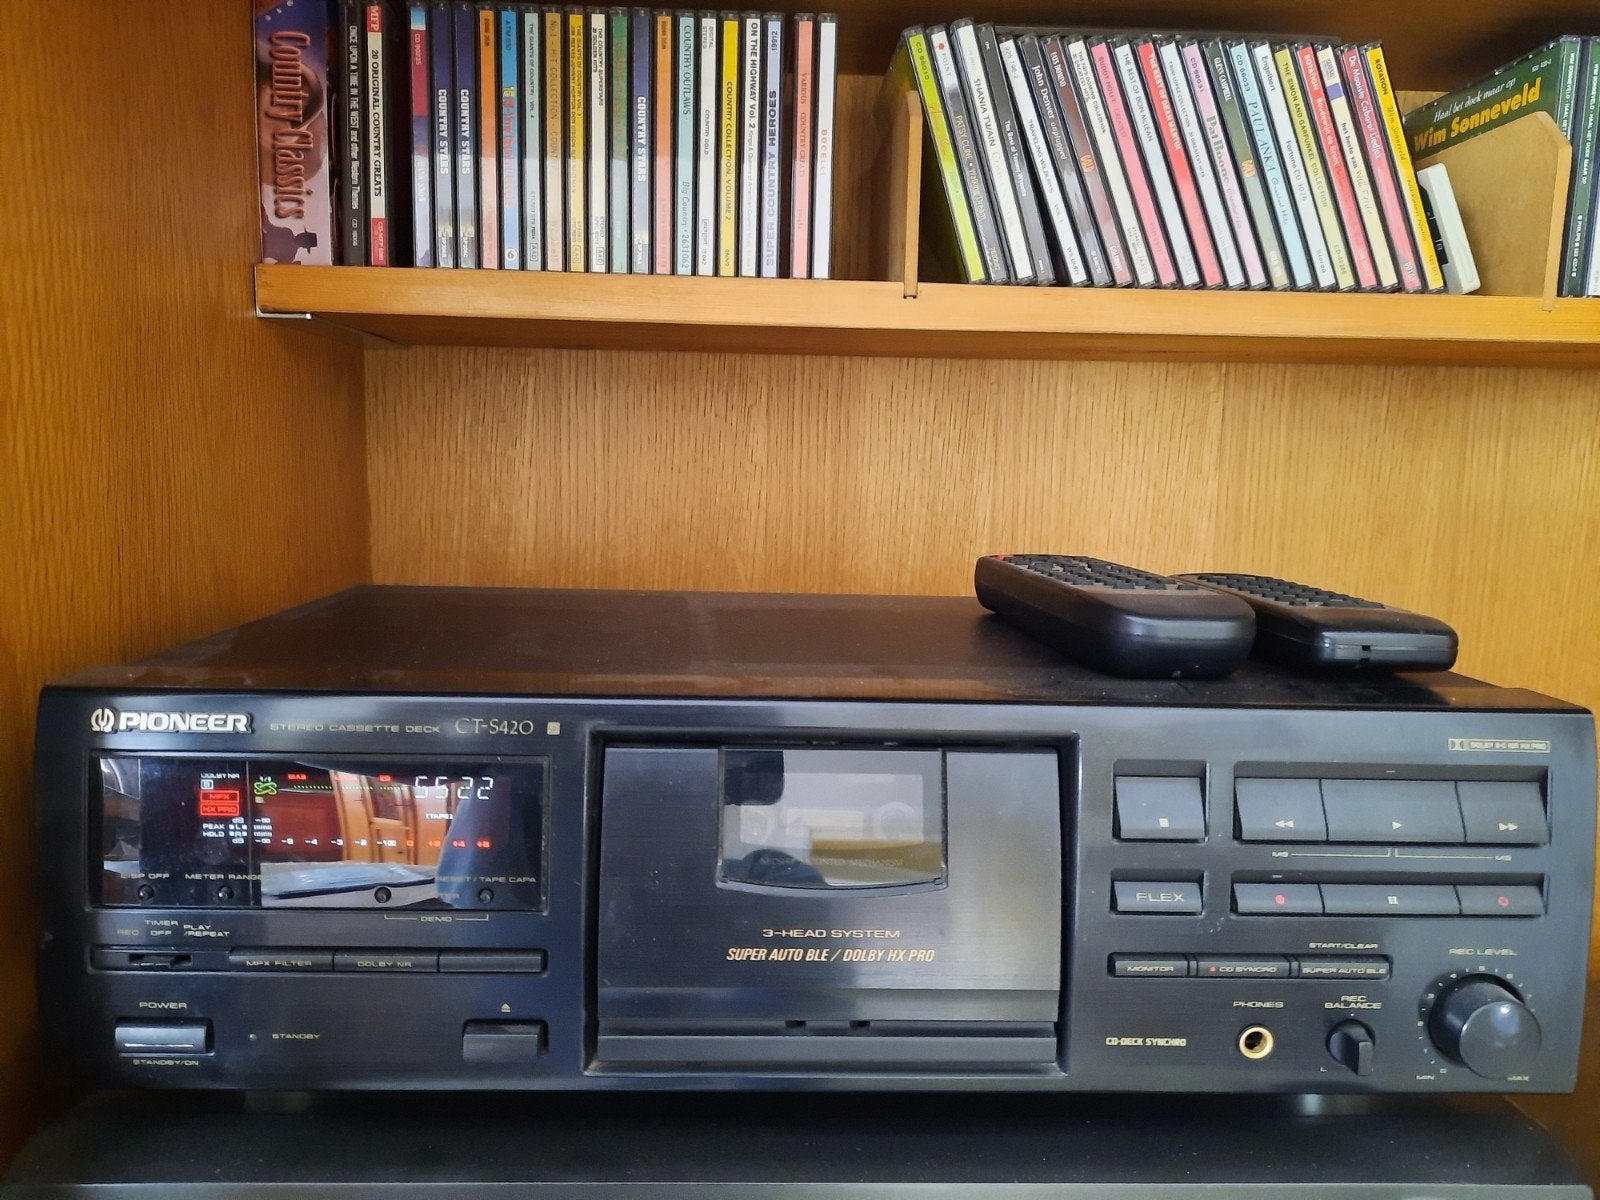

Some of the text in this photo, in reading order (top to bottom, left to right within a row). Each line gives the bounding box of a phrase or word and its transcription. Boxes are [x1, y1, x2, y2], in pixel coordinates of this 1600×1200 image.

[370, 6, 380, 31] MFP
[750, 22, 758, 36] ON
[415, 34, 420, 43] CD
[750, 39, 758, 58] THE
[915, 41, 923, 53] CD
[550, 49, 558, 64] HIT
[682, 26, 692, 115] COUNTRY OUTLAWS
[940, 52, 951, 76] POINT
[1049, 51, 1067, 87] FATS DOMINO
[1122, 52, 1131, 66] THE
[1189, 56, 1197, 68] CD
[1235, 53, 1243, 65] CD
[1260, 55, 1276, 91] Engelbert
[750, 60, 758, 102] HIGHWAY
[800, 72, 808, 104] VARIOUS
[1097, 56, 1116, 102] BUDDY HOLLY
[1126, 67, 1136, 83] BEST
[1131, 84, 1139, 93] OF
[1218, 74, 1232, 101] CAMPBELL
[550, 68, 558, 119] COLLECTION
[1134, 95, 1145, 113] DON
[1148, 54, 1181, 150] THE BEST OF DEAN MARTIN
[1303, 53, 1340, 165] ROTATION Boudewijn de Groot
[1348, 55, 1383, 159] De Mooiste Cabaret Liedjes
[1374, 58, 1388, 95] ROTATION
[1391, 125, 1407, 161] Sonneveld
[265, 32, 313, 218] Country Classics
[372, 50, 382, 198] 20 ORIGINAL COUNTRY GREATS
[973, 78, 996, 147] SHANIA TWAIN
[1031, 64, 1068, 160] John Denver unplugged
[1414, 76, 1542, 153] Wim Sonneveld
[438, 88, 449, 174] COUNTRY STARS
[460, 88, 471, 174] COUNTRY STARS
[638, 96, 647, 182] COUNTRY STARS
[800, 112, 808, 149] COUNTRY
[1247, 100, 1275, 172] PAUL ANKA
[1281, 62, 1328, 208] THE SIMON AND GARFUNKEL COLLECTION
[1341, 122, 1358, 169] het beste van
[1026, 119, 1054, 193] TRAVELING WILBURYS
[1079, 153, 1095, 173] GOLD
[1205, 115, 1234, 184] Pat Boone
[1284, 140, 1301, 181] Fortune CD
[767, 90, 777, 266] SUPER COUNTRY HEROES
[1239, 158, 1256, 178] GOLD
[682, 182, 690, 195] Big
[682, 234, 690, 268] 2631062
[118, 711, 252, 733] PIONEER
[328, 724, 400, 733] CASSETTE
[406, 725, 440, 734] DECK
[454, 718, 534, 735] CT-S420
[1136, 892, 1184, 902] FLEX
[762, 929, 900, 938] 3-HEAD SYSTEM
[726, 948, 935, 963] SUPER AUTO BLE / DOLBY HX PRO
[1106, 1037, 1187, 1047] CD-DECK SYNCHRO
